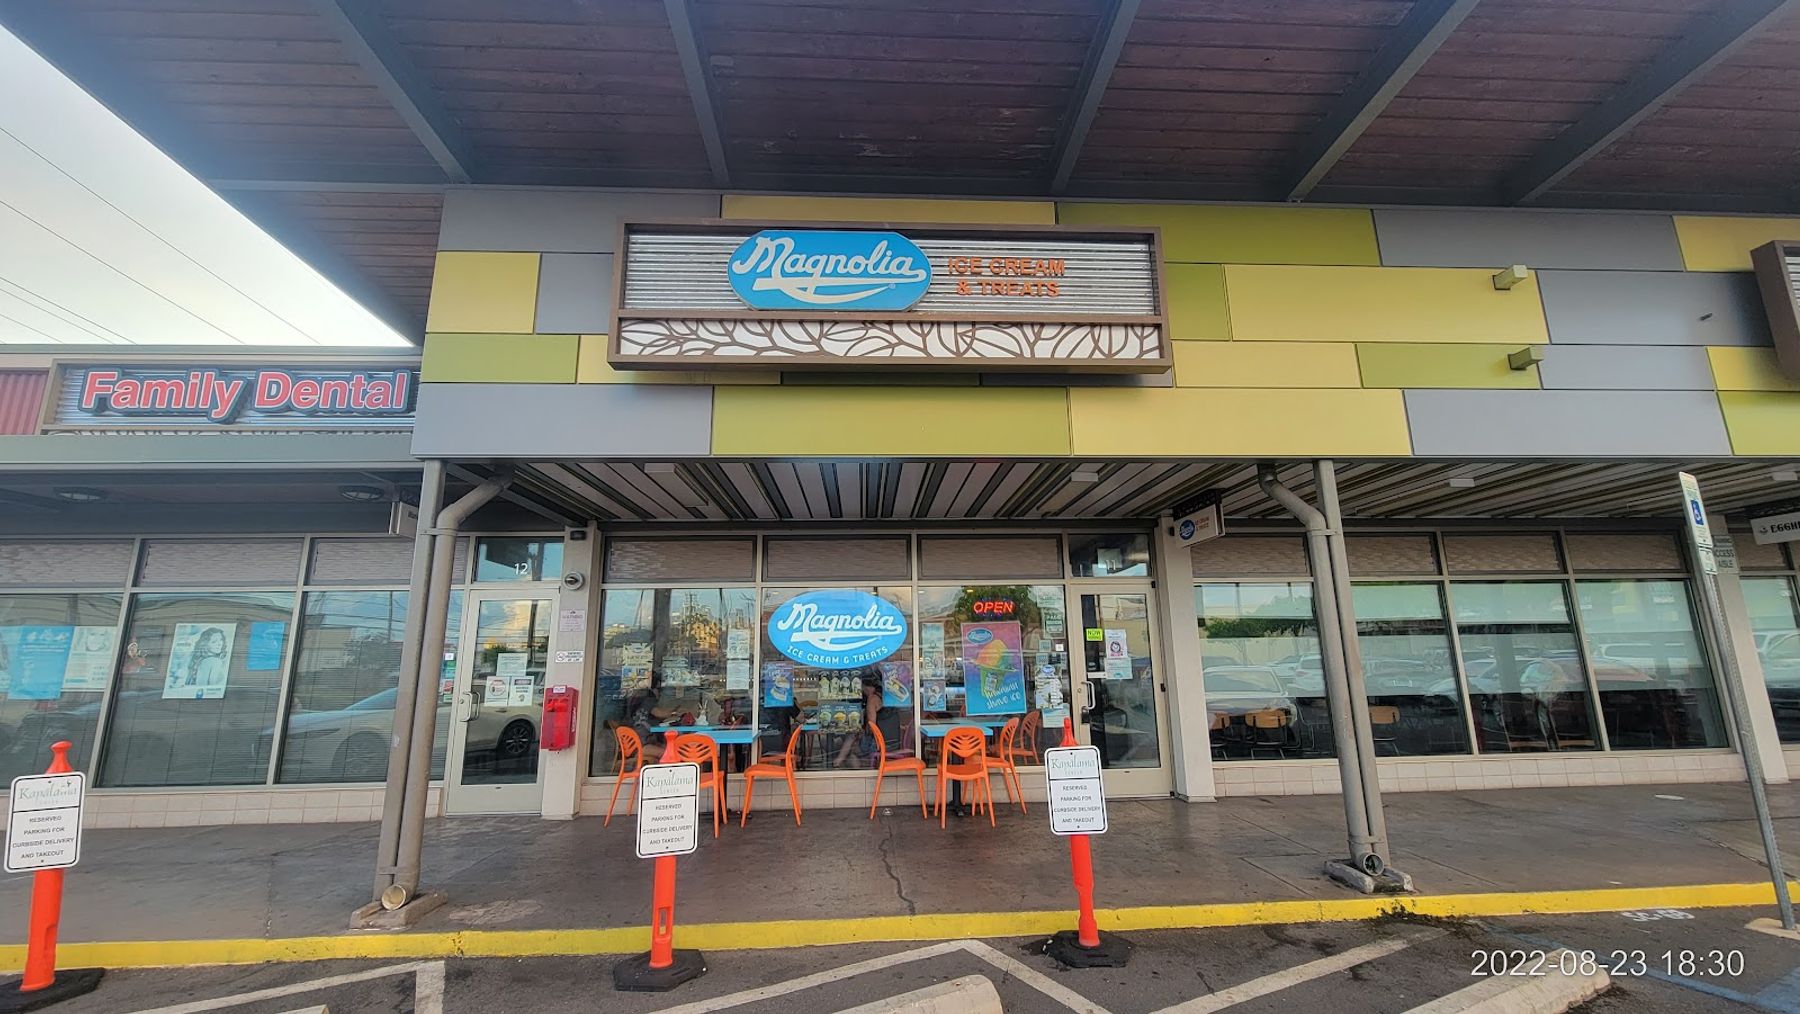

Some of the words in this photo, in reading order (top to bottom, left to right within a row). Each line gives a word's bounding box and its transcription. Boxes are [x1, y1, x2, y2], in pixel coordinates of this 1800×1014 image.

[731, 236, 928, 304] Magnolia
[947, 256, 983, 275] ICE
[989, 257, 1065, 276] CREAM
[956, 279, 972, 296] &
[977, 280, 1060, 297] TREATS
[81, 371, 243, 420] Family
[253, 371, 407, 409] Dental
[514, 562, 529, 575] 12
[973, 601, 1014, 614] OPEN
[777, 602, 903, 651] Magnolia
[786, 645, 804, 658] ICE
[807, 653, 839, 664] CREAM
[852, 646, 888, 663] TREATS
[12, 840, 42, 848] CURBSIDE
[36, 850, 64, 858] TAKEOUT
